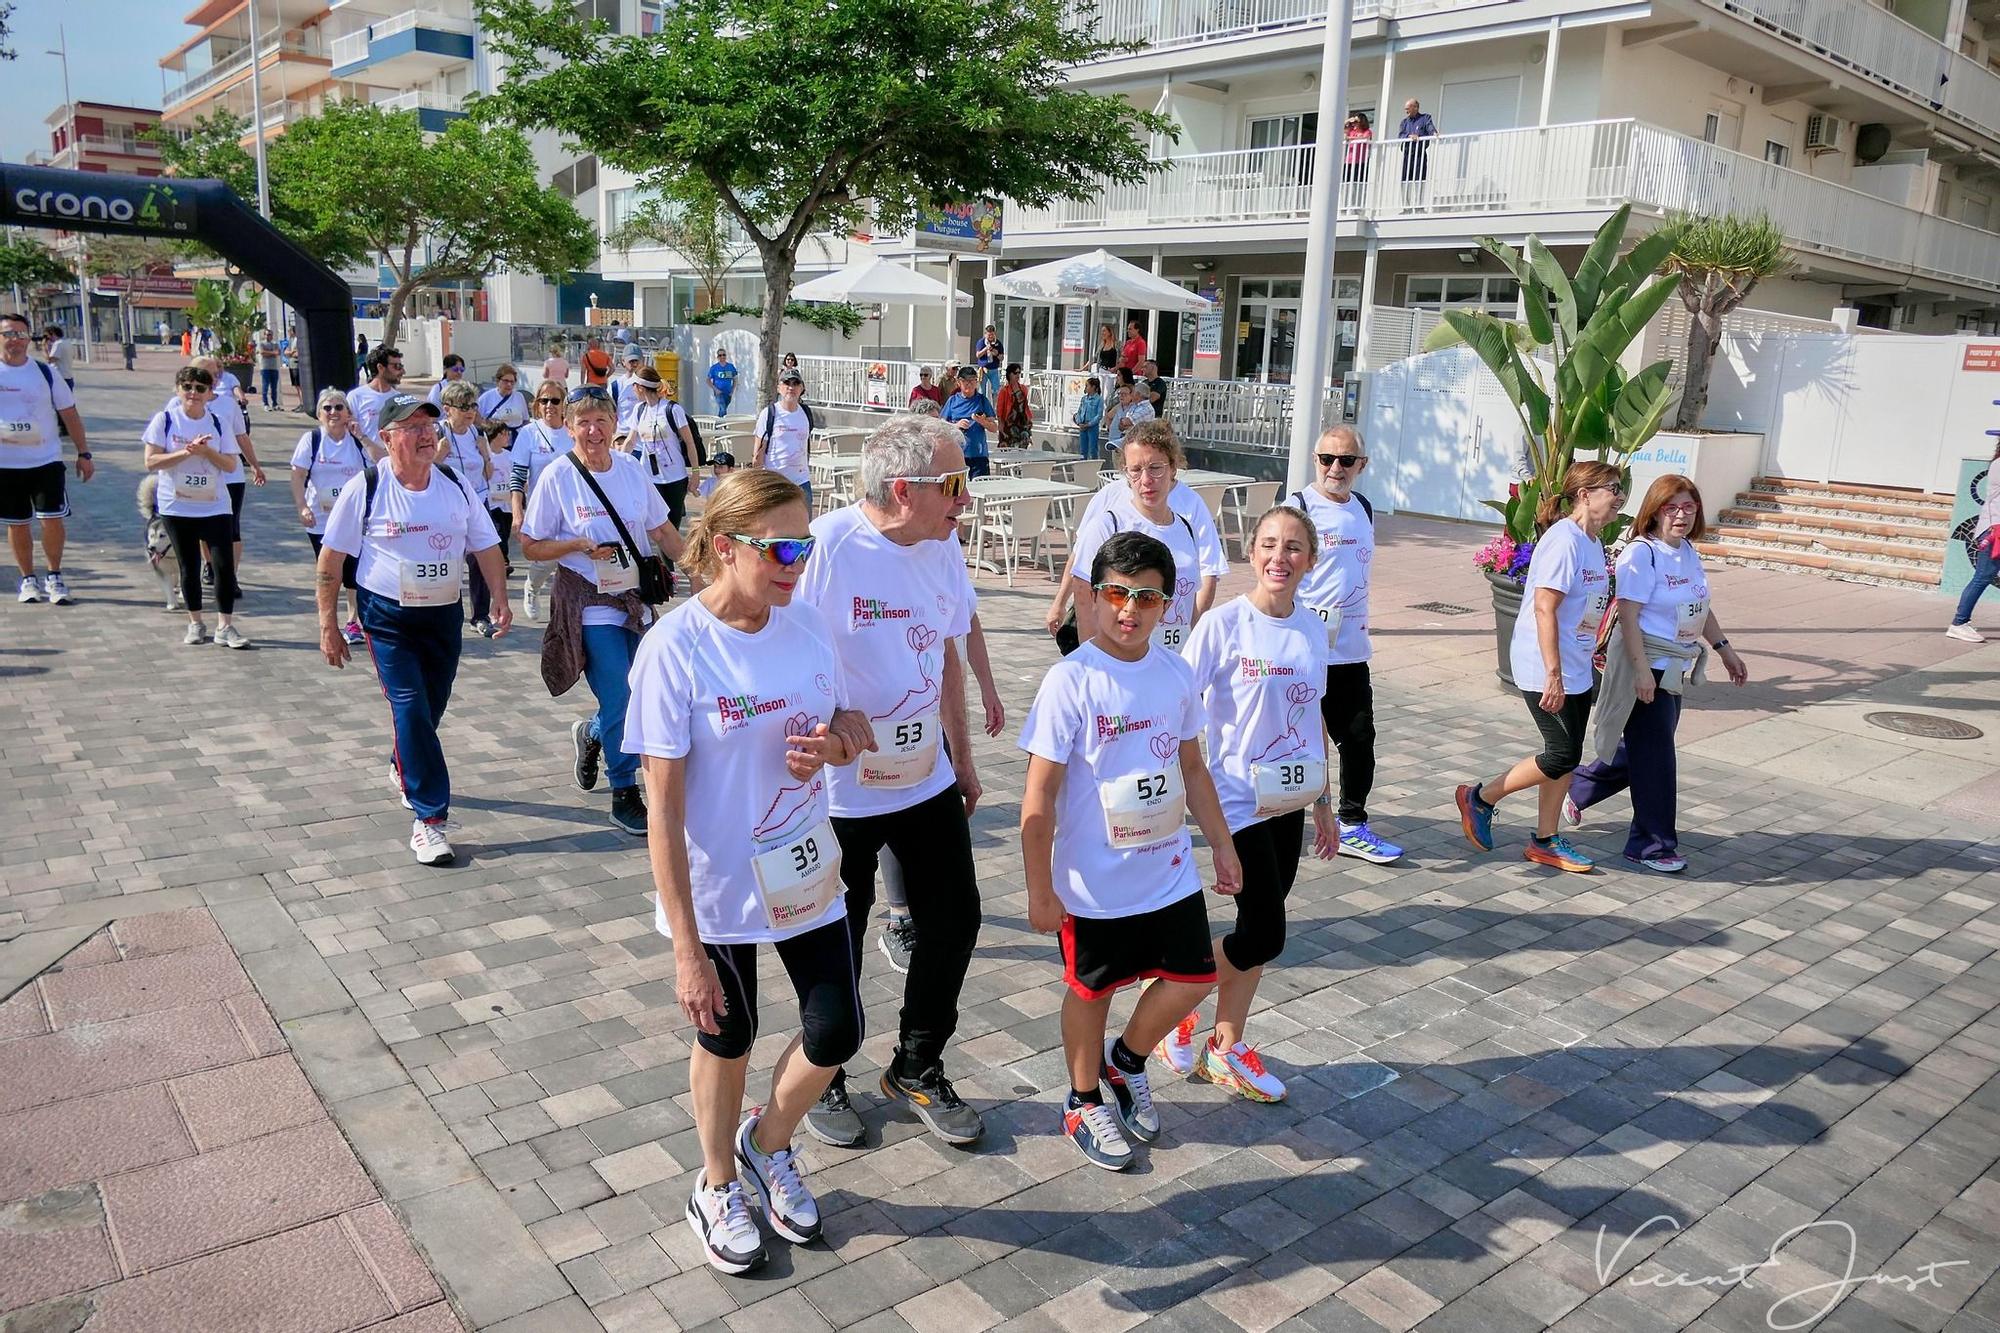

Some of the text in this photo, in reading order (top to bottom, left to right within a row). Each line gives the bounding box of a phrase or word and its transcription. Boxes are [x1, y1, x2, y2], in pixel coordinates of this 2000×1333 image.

[15, 188, 135, 221] crono
[947, 217, 969, 227] house
[9, 422, 32, 432] 399
[1655, 448, 1687, 464] Bella
[185, 475, 208, 486] 238
[386, 524, 429, 535] Parkinson
[1324, 538, 1358, 547] Parkinson
[416, 562, 449, 578] 338
[853, 596, 889, 608] Run for
[853, 607, 911, 620] Parkinson
[1163, 629, 1181, 646] 56
[1241, 657, 1263, 667] Run
[1242, 665, 1294, 677] Parkinson
[717, 694, 759, 710] Run for
[720, 691, 804, 723] Parkinson VIII
[1096, 714, 1121, 727] Run
[895, 722, 923, 746] 53
[1098, 719, 1152, 738] Parkinson
[863, 773, 900, 781] Parkinson
[1280, 765, 1305, 785] 38
[1136, 774, 1168, 801] 52
[1146, 797, 1162, 807] ENZO
[1113, 825, 1129, 833] Run
[1114, 828, 1151, 839] Parkinson
[790, 837, 819, 872] 39
[772, 904, 791, 914] Run
[774, 901, 816, 921] Parkinson
